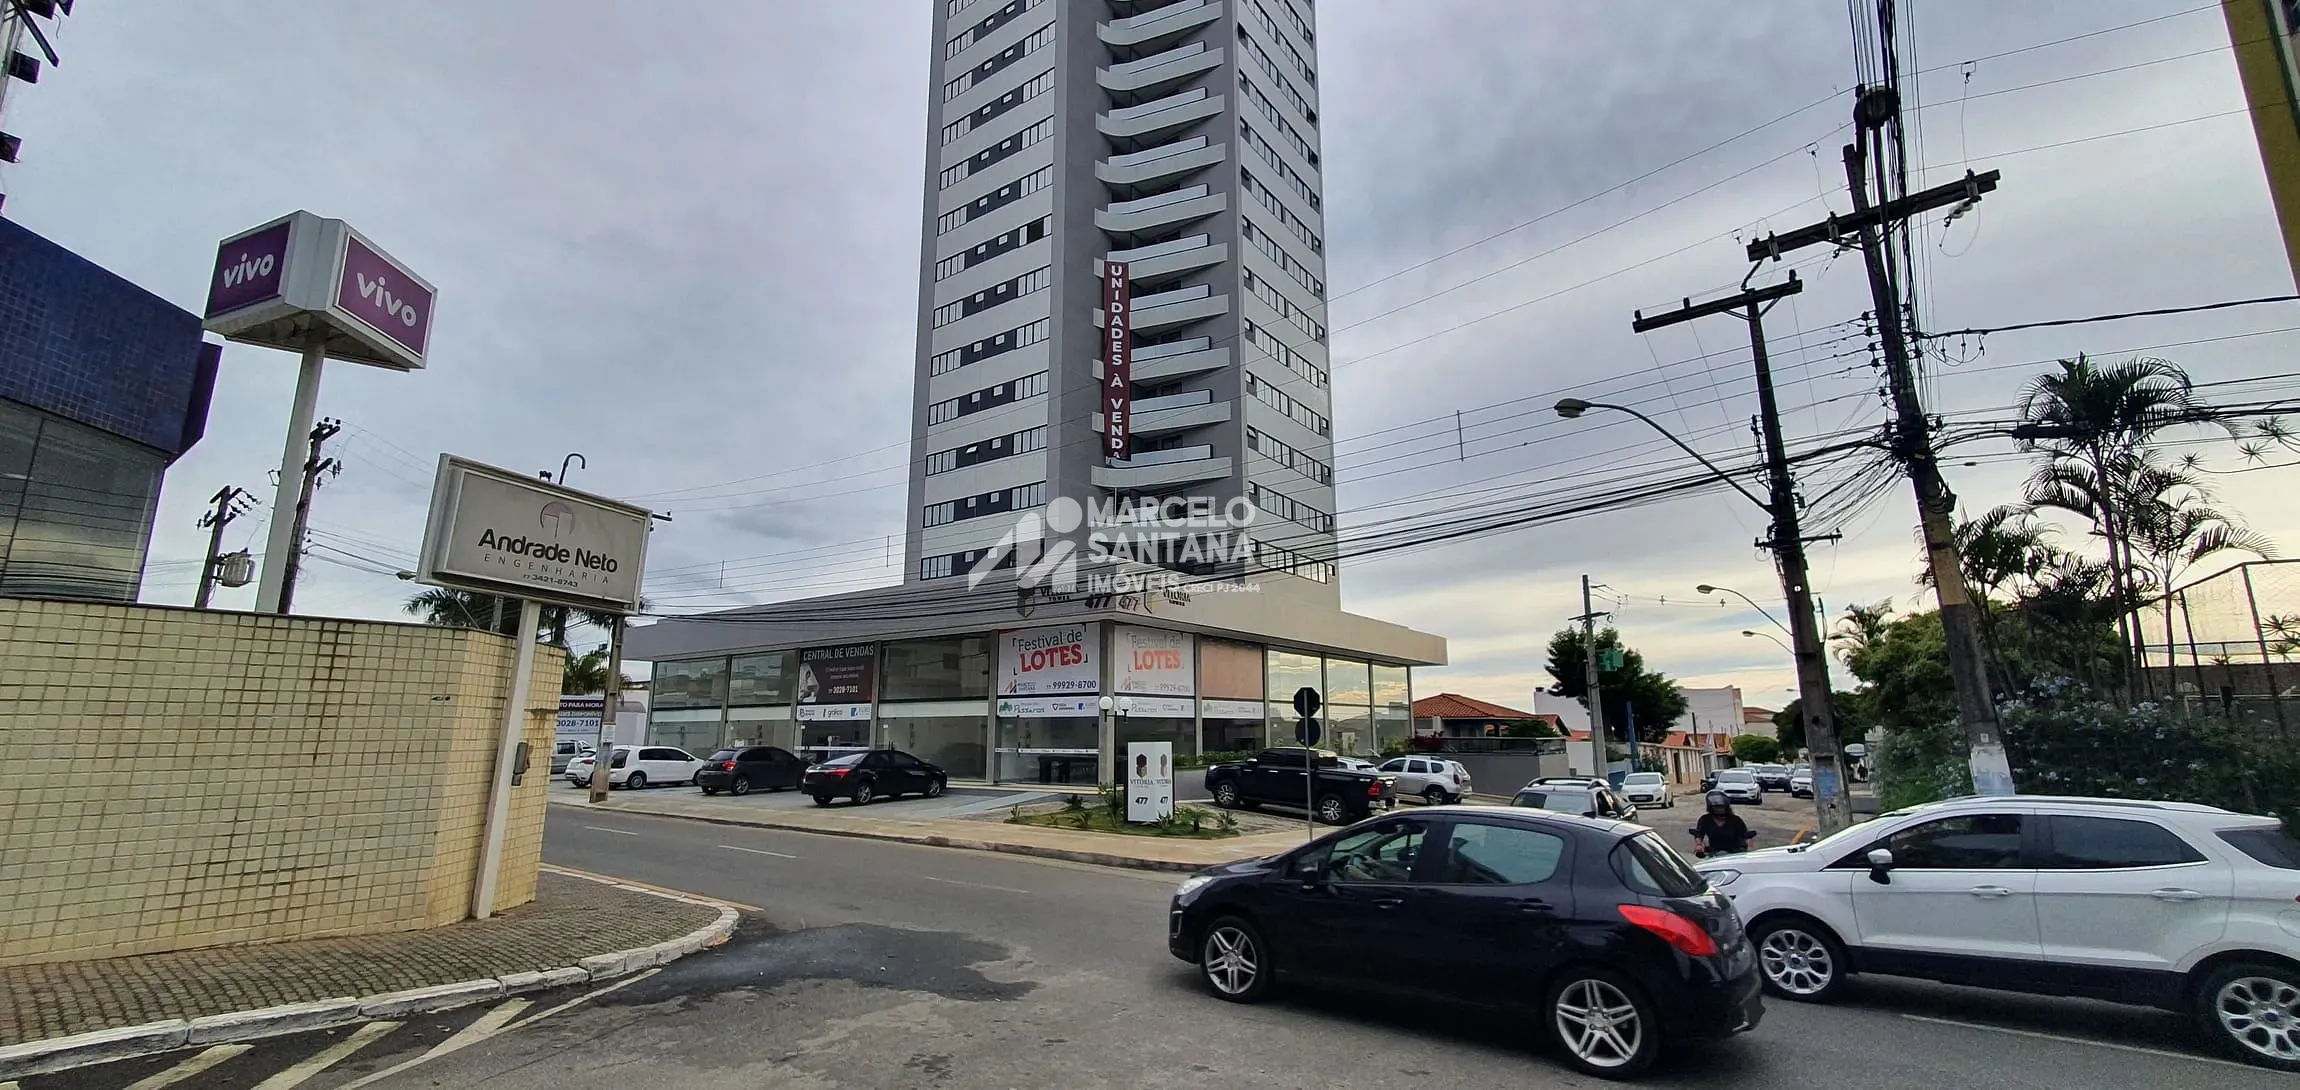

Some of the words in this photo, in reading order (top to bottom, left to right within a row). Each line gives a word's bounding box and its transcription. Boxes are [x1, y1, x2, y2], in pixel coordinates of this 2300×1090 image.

[223, 252, 275, 289] vivo
[357, 272, 417, 327] vivo
[1111, 264, 1124, 366] UNIDADES
[478, 529, 571, 564] Andrade
[574, 547, 618, 573] Neto
[484, 553, 609, 584] ENGENHARIA
[803, 648, 833, 661] CENTRAL
[834, 647, 845, 658] DE
[845, 645, 874, 657] VENDAS
[1018, 632, 1064, 652] Festival
[1066, 629, 1083, 643] de
[1020, 643, 1083, 673] LOTES
[1133, 649, 1181, 671] LOTES
